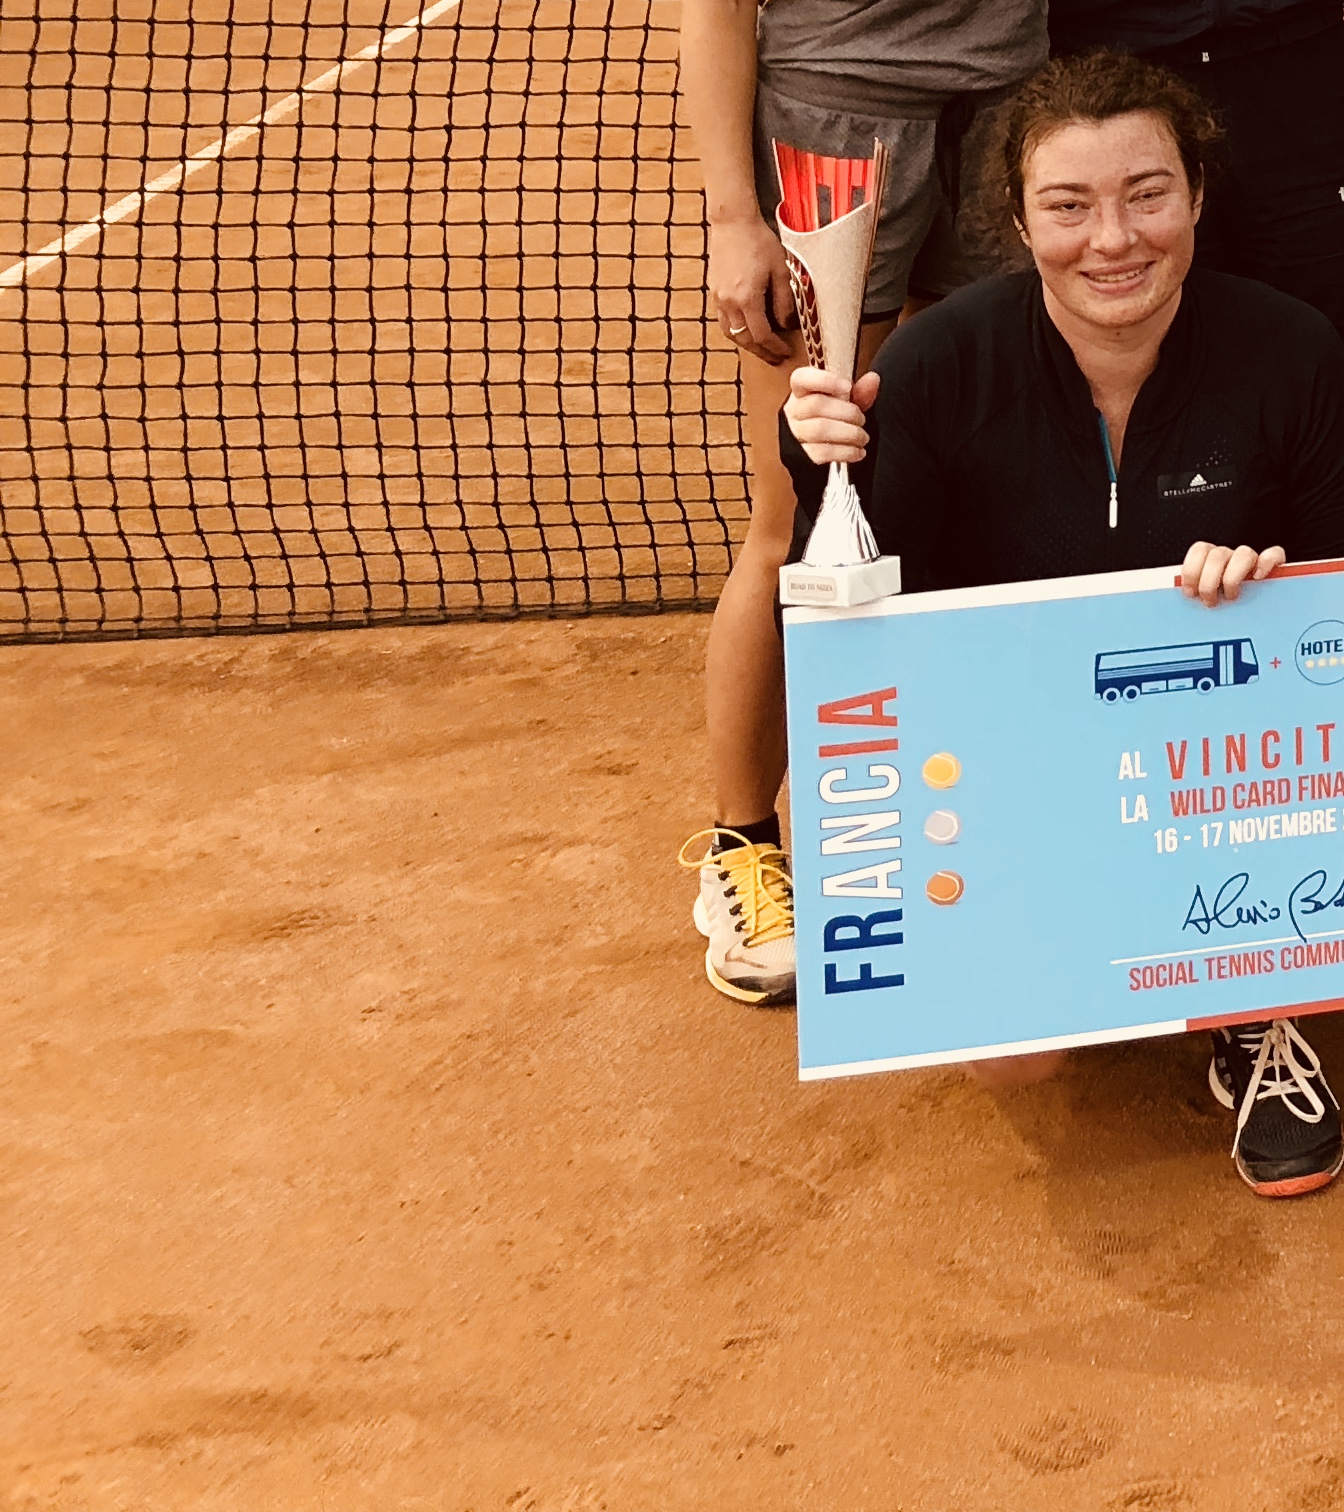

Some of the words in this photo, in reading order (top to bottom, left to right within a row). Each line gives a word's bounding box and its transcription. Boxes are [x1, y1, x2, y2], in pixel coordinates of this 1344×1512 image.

[1118, 751, 1147, 780] AL
[1120, 794, 1149, 824] LA
[1170, 786, 1226, 818] WILD
[1233, 778, 1291, 809] CARD
[818, 686, 904, 995] FRANCIA
[1154, 828, 1178, 853] 16
[1200, 822, 1223, 847] 17
[1229, 808, 1337, 845] NOVEMBRE
[1129, 962, 1199, 991] SOCIAL
[1204, 949, 1275, 980] TENNIS
